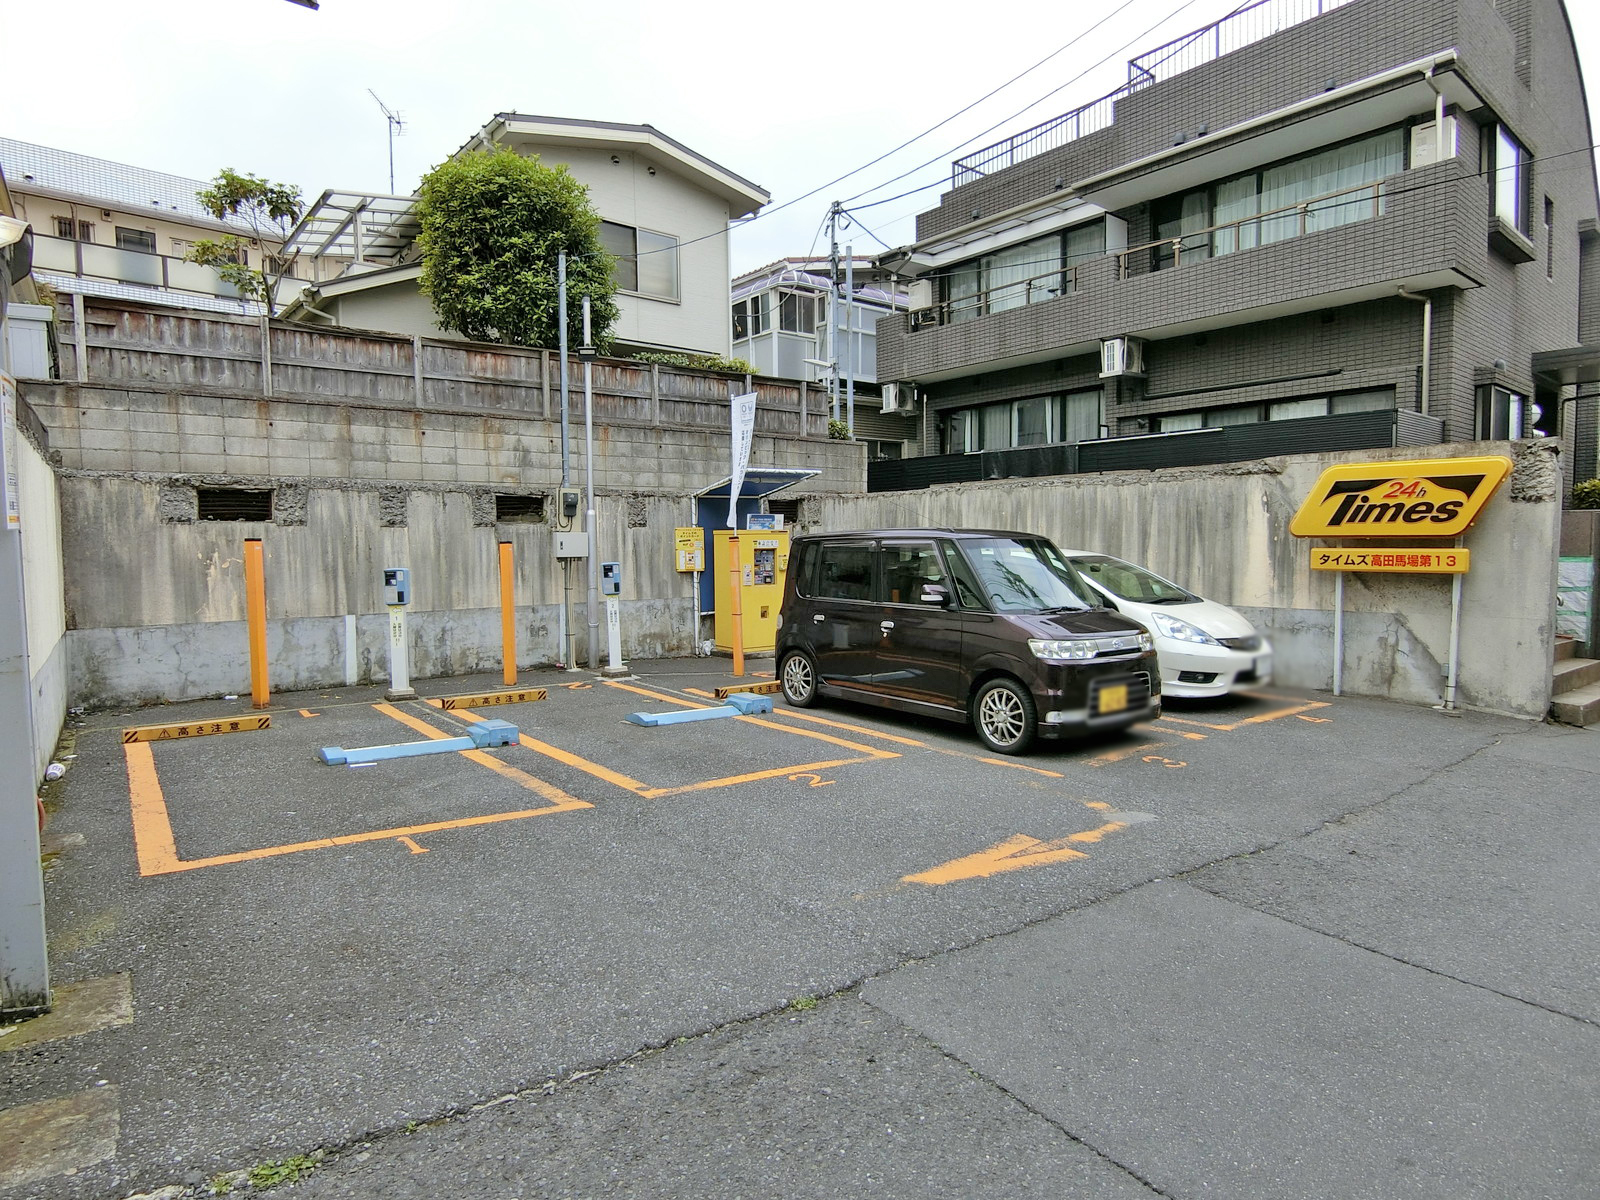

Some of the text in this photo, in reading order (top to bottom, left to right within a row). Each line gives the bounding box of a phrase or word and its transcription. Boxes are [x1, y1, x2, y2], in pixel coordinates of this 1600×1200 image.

[1320, 475, 1487, 527] Times
[482, 694, 526, 705] 高さ注意
[177, 721, 240, 737] 高さ注意
[1141, 754, 1188, 769] 3
[788, 773, 837, 788] 2
